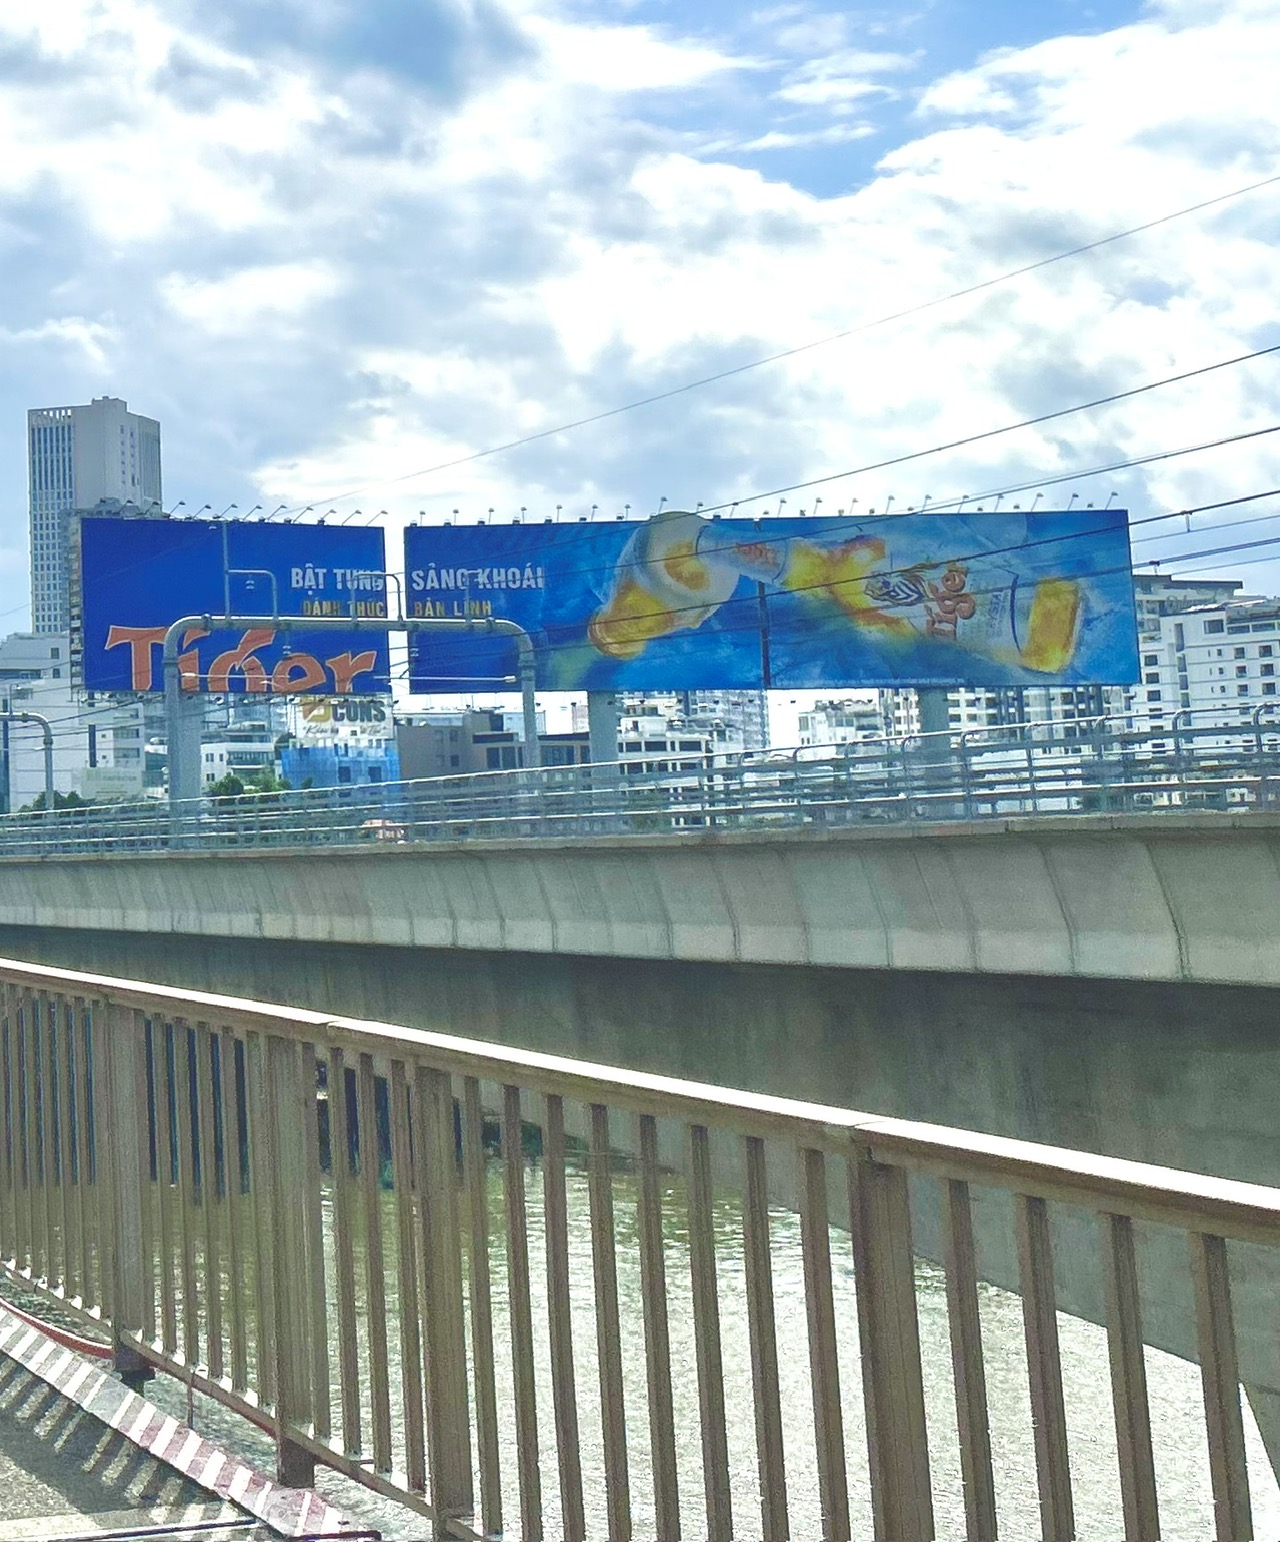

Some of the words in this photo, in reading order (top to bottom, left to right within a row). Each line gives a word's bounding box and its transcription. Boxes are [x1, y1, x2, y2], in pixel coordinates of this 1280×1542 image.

[291, 563, 327, 595] BẬT
[411, 563, 468, 590] SẢNG
[478, 563, 544, 589] KHOÁI
